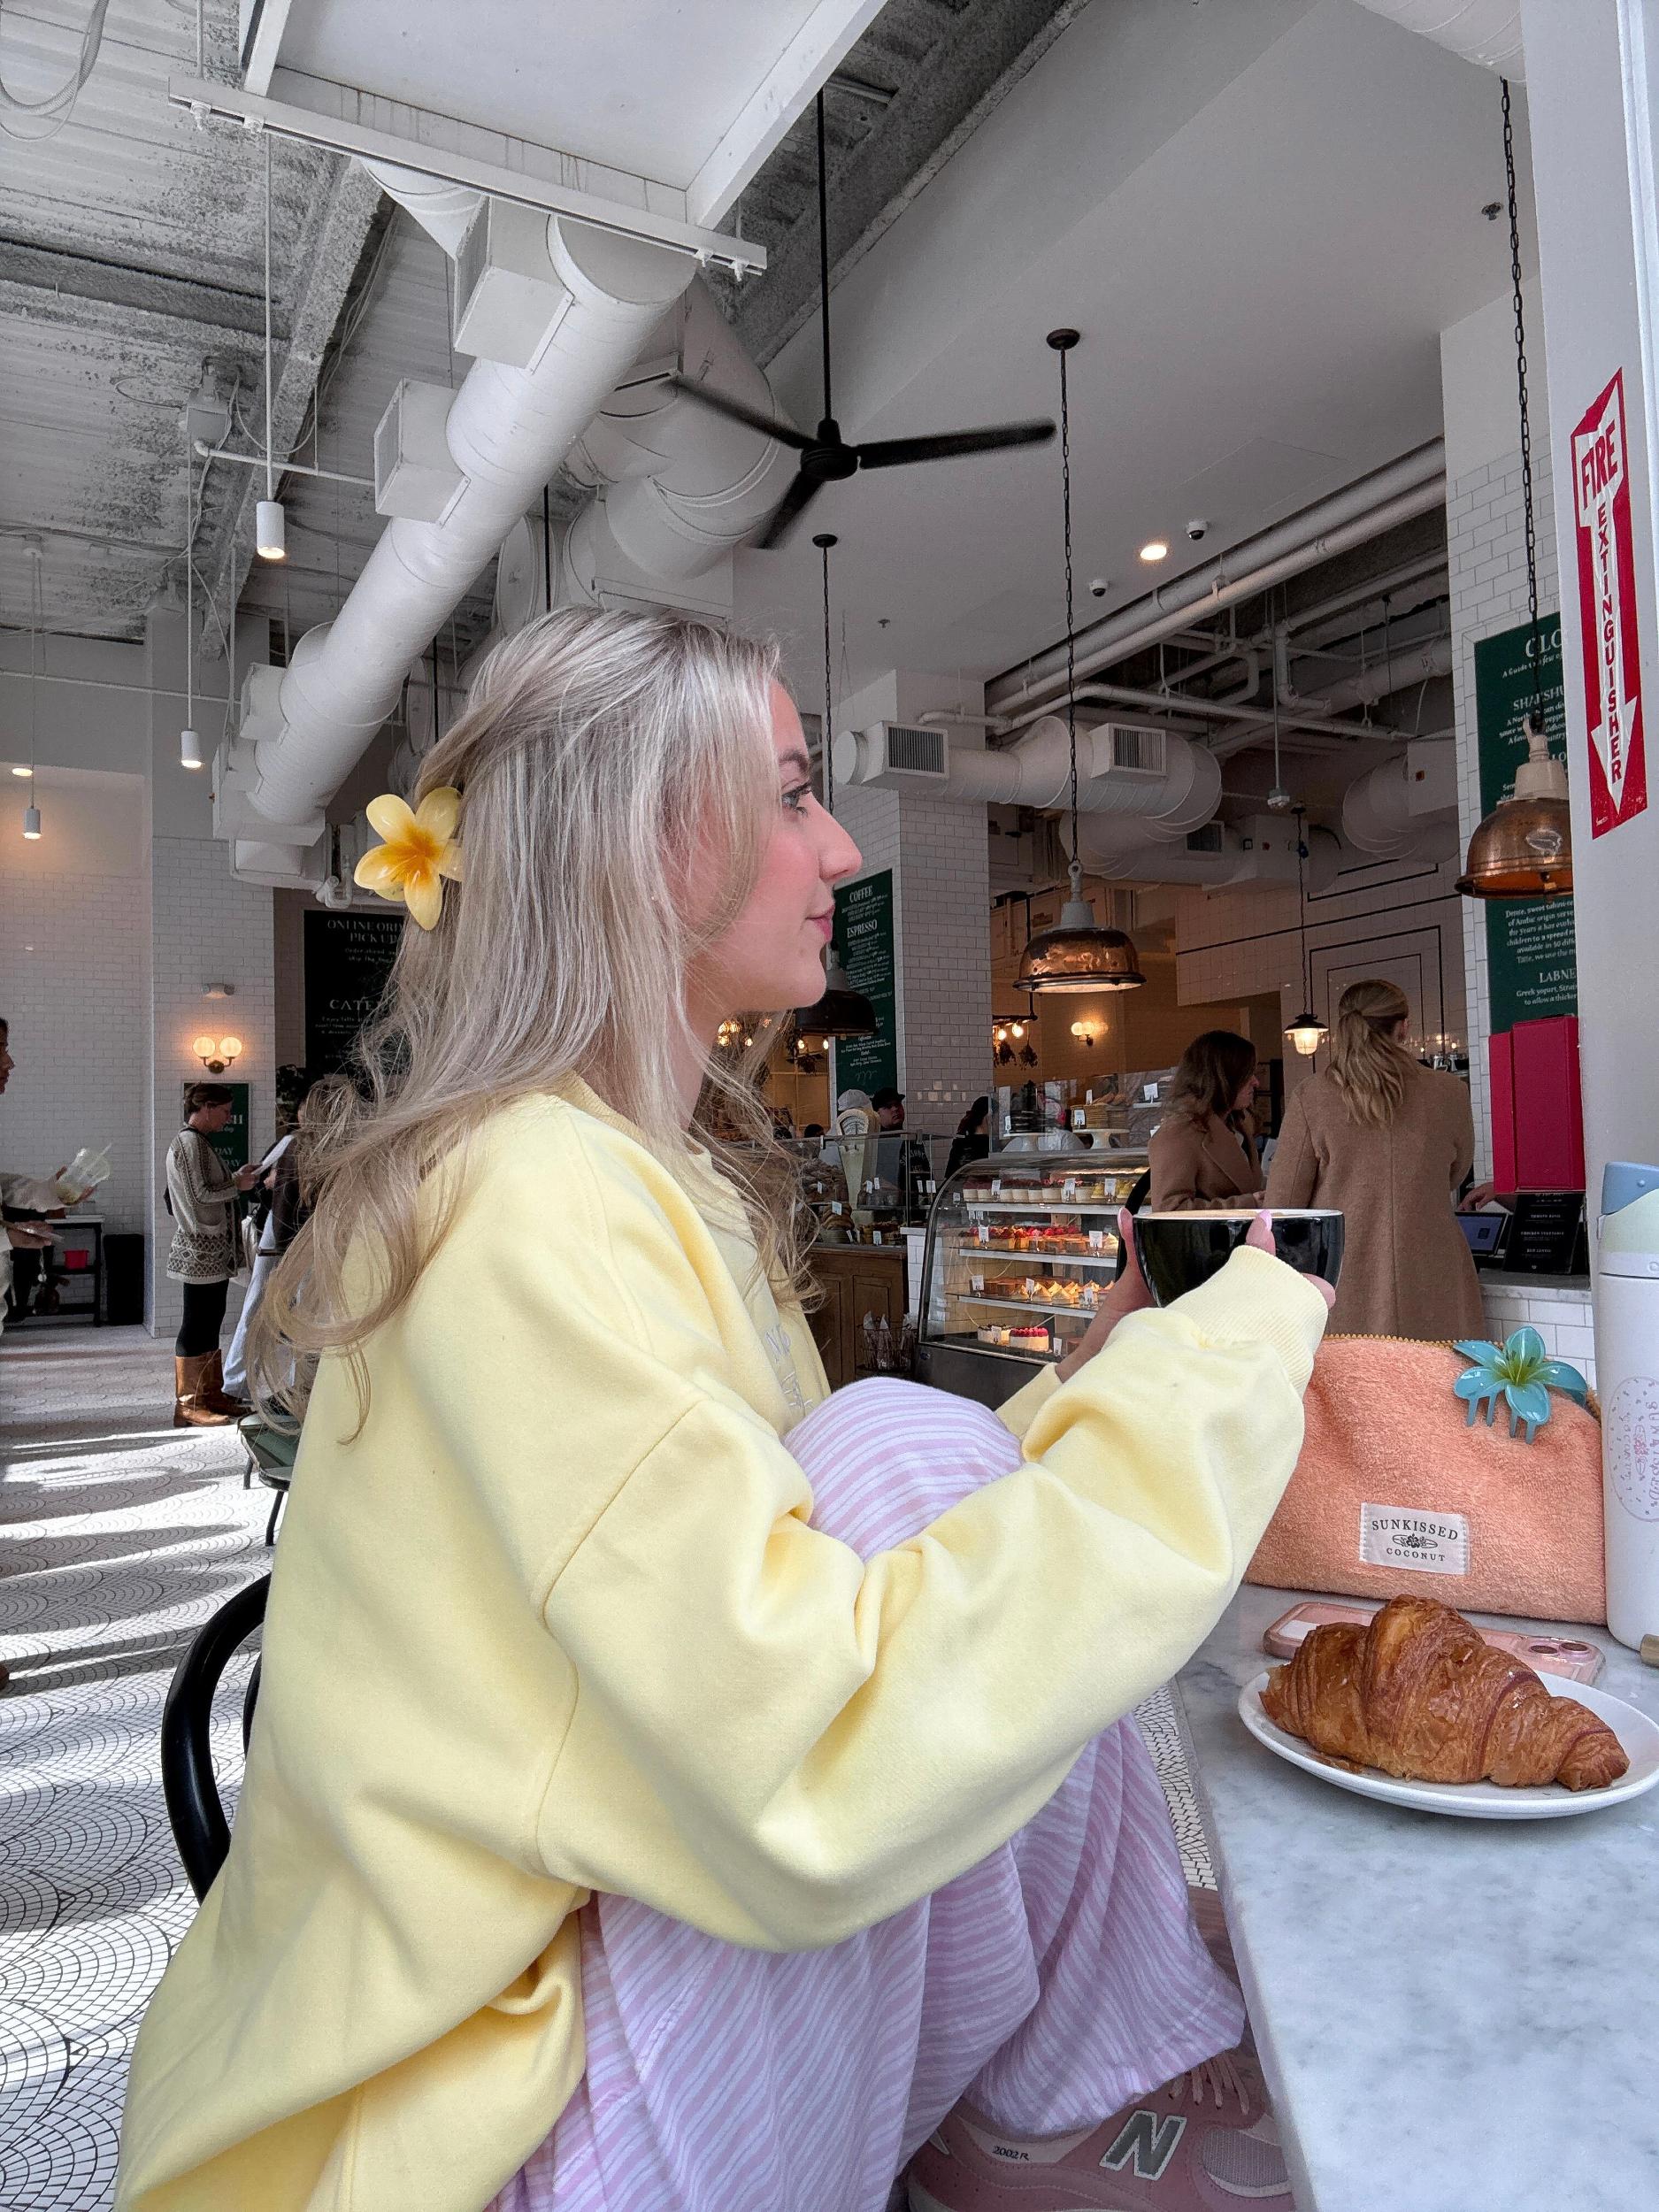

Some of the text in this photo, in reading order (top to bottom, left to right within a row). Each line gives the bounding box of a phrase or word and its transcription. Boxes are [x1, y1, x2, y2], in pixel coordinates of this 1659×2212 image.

[1581, 419, 1617, 511] FIRE
[1596, 502, 1623, 785] EXTINGUISHER
[849, 885, 873, 902] COFFEE
[847, 919, 878, 939] ESPRESSO
[1516, 987, 1537, 997] Greek
[1371, 1519, 1458, 1540] SUNKISSED
[1386, 1548, 1446, 1562] COCONUT
[1099, 2109, 1187, 2180] N
